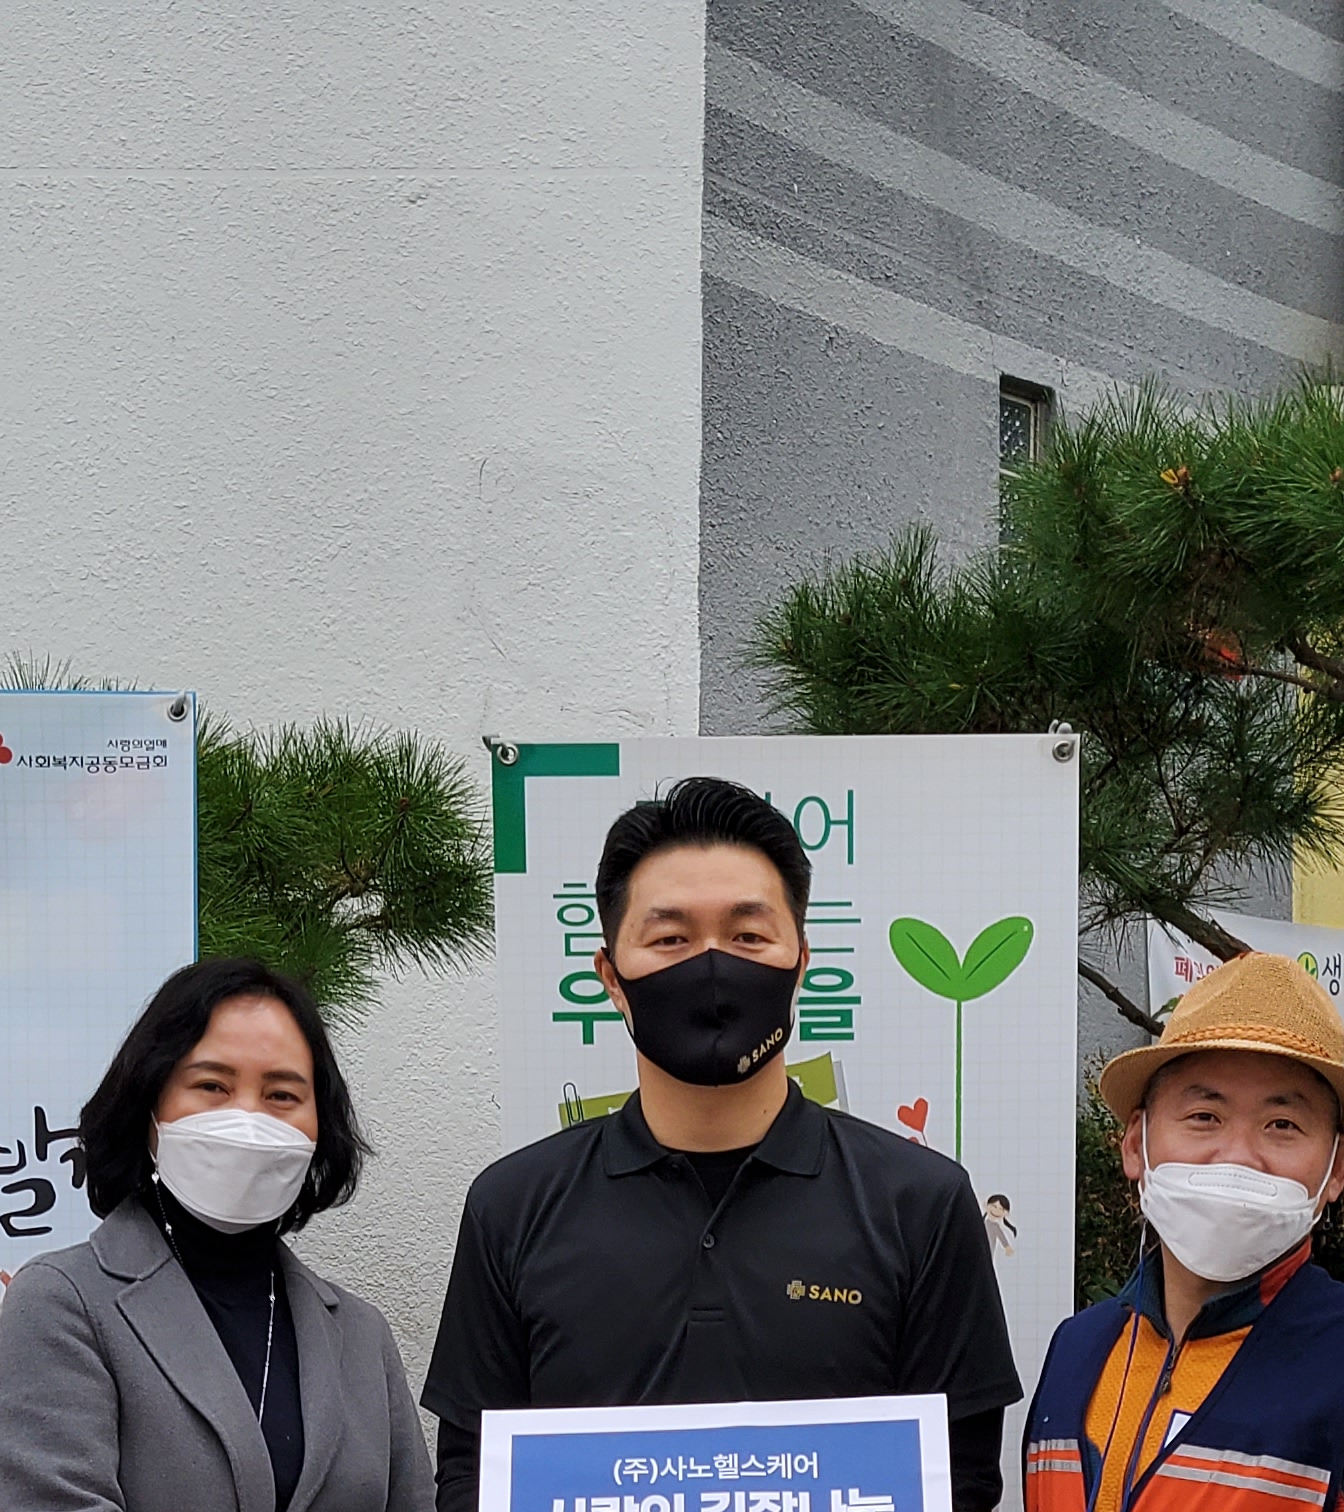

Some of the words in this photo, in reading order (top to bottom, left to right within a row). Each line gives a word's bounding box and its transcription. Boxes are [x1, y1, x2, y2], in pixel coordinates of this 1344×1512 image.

[16, 754, 168, 774] 사회복지공동모금회
[751, 1028, 784, 1063] SANO
[808, 1284, 863, 1305] SANO
[612, 1452, 820, 1486] (주)사노헬스케어
